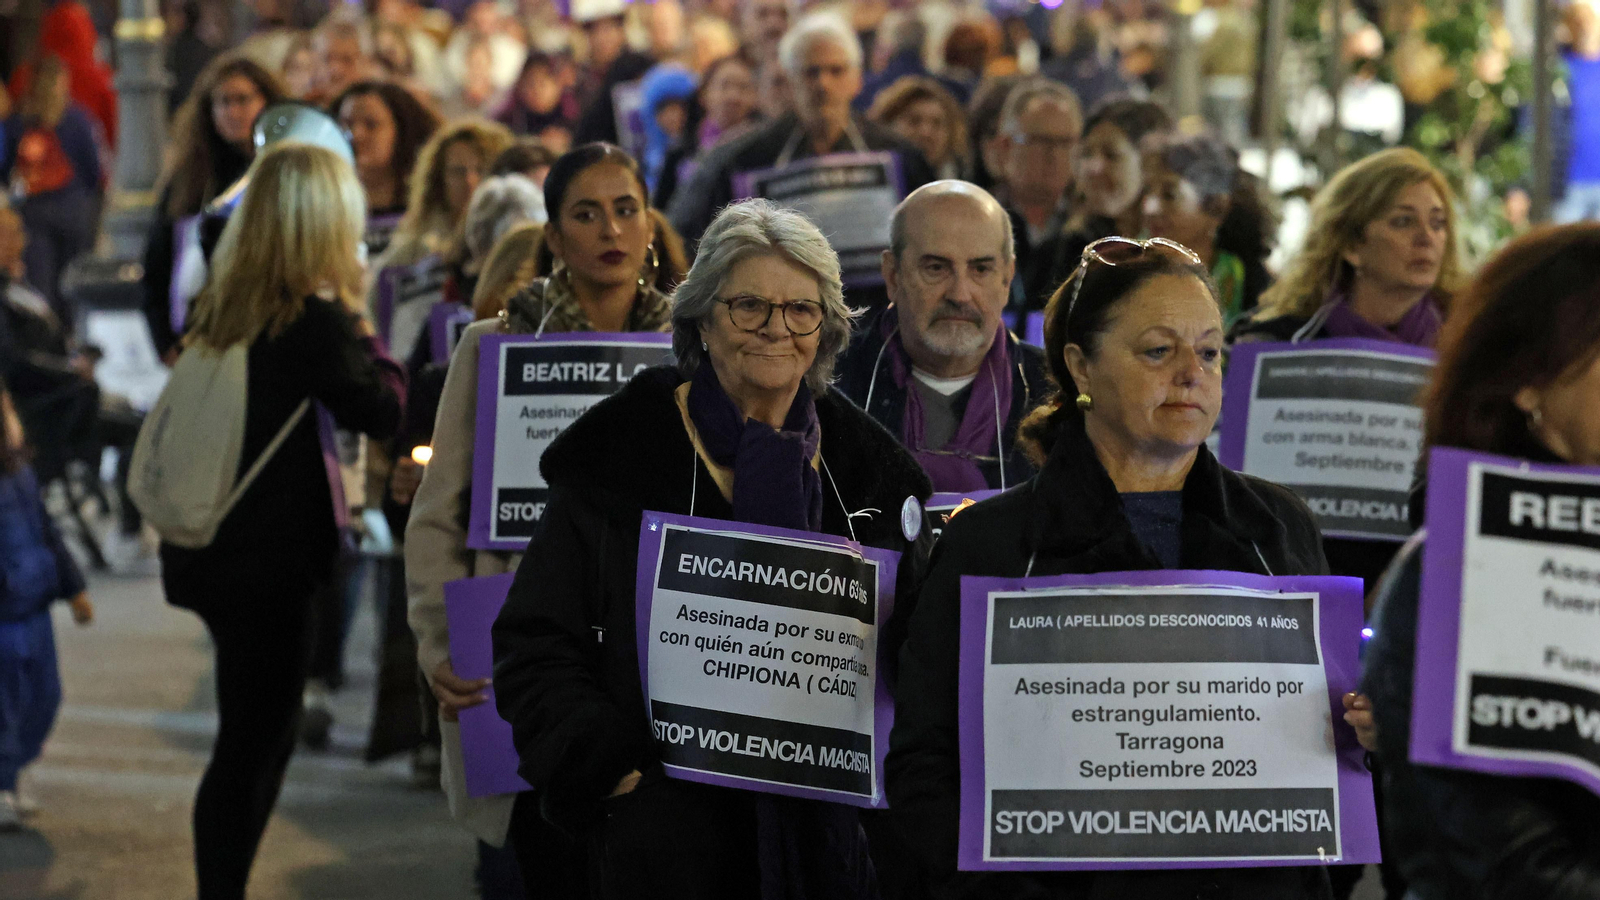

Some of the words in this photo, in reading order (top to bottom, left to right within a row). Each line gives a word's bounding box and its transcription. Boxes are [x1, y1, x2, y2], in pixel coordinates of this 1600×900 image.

[523, 362, 611, 382] BEATRIZ
[1274, 408, 1363, 425] Asesinada
[1368, 413, 1397, 428] por
[1262, 431, 1294, 445] con
[1300, 432, 1344, 445] arma
[1294, 451, 1405, 473] Septiembre
[678, 553, 847, 596] ENCARNACIÓN
[676, 604, 768, 632] Asesinada
[774, 623, 809, 638] por
[814, 627, 835, 642] su
[1009, 616, 1053, 629] LAURA
[1063, 614, 1145, 628] APELLIDOS
[1149, 614, 1253, 627] DESCONOCIDOS
[1256, 616, 1269, 628] 41
[1270, 614, 1299, 630] AÑOS
[659, 630, 689, 646] con
[694, 634, 743, 654] quién
[748, 641, 784, 661] aún
[703, 659, 801, 689] CHIPIONA
[1014, 677, 1125, 695] Asesinada
[1133, 681, 1170, 698] por
[1177, 680, 1201, 694] su
[1207, 677, 1271, 694] marido
[1277, 680, 1304, 698] por
[1071, 704, 1261, 726] estrangulamiento.
[1470, 694, 1572, 731] STOP
[653, 719, 695, 745] STOP
[698, 727, 815, 765] VIOLENCIA
[818, 746, 870, 774] MACHISTA
[1116, 733, 1224, 753] Tarragona
[1079, 760, 1205, 782] Septiembre
[1212, 760, 1257, 777] 2023
[995, 811, 1064, 834] STOP
[1068, 810, 1211, 834] VIOLENCIA
[1216, 809, 1332, 833] MACHISTA
